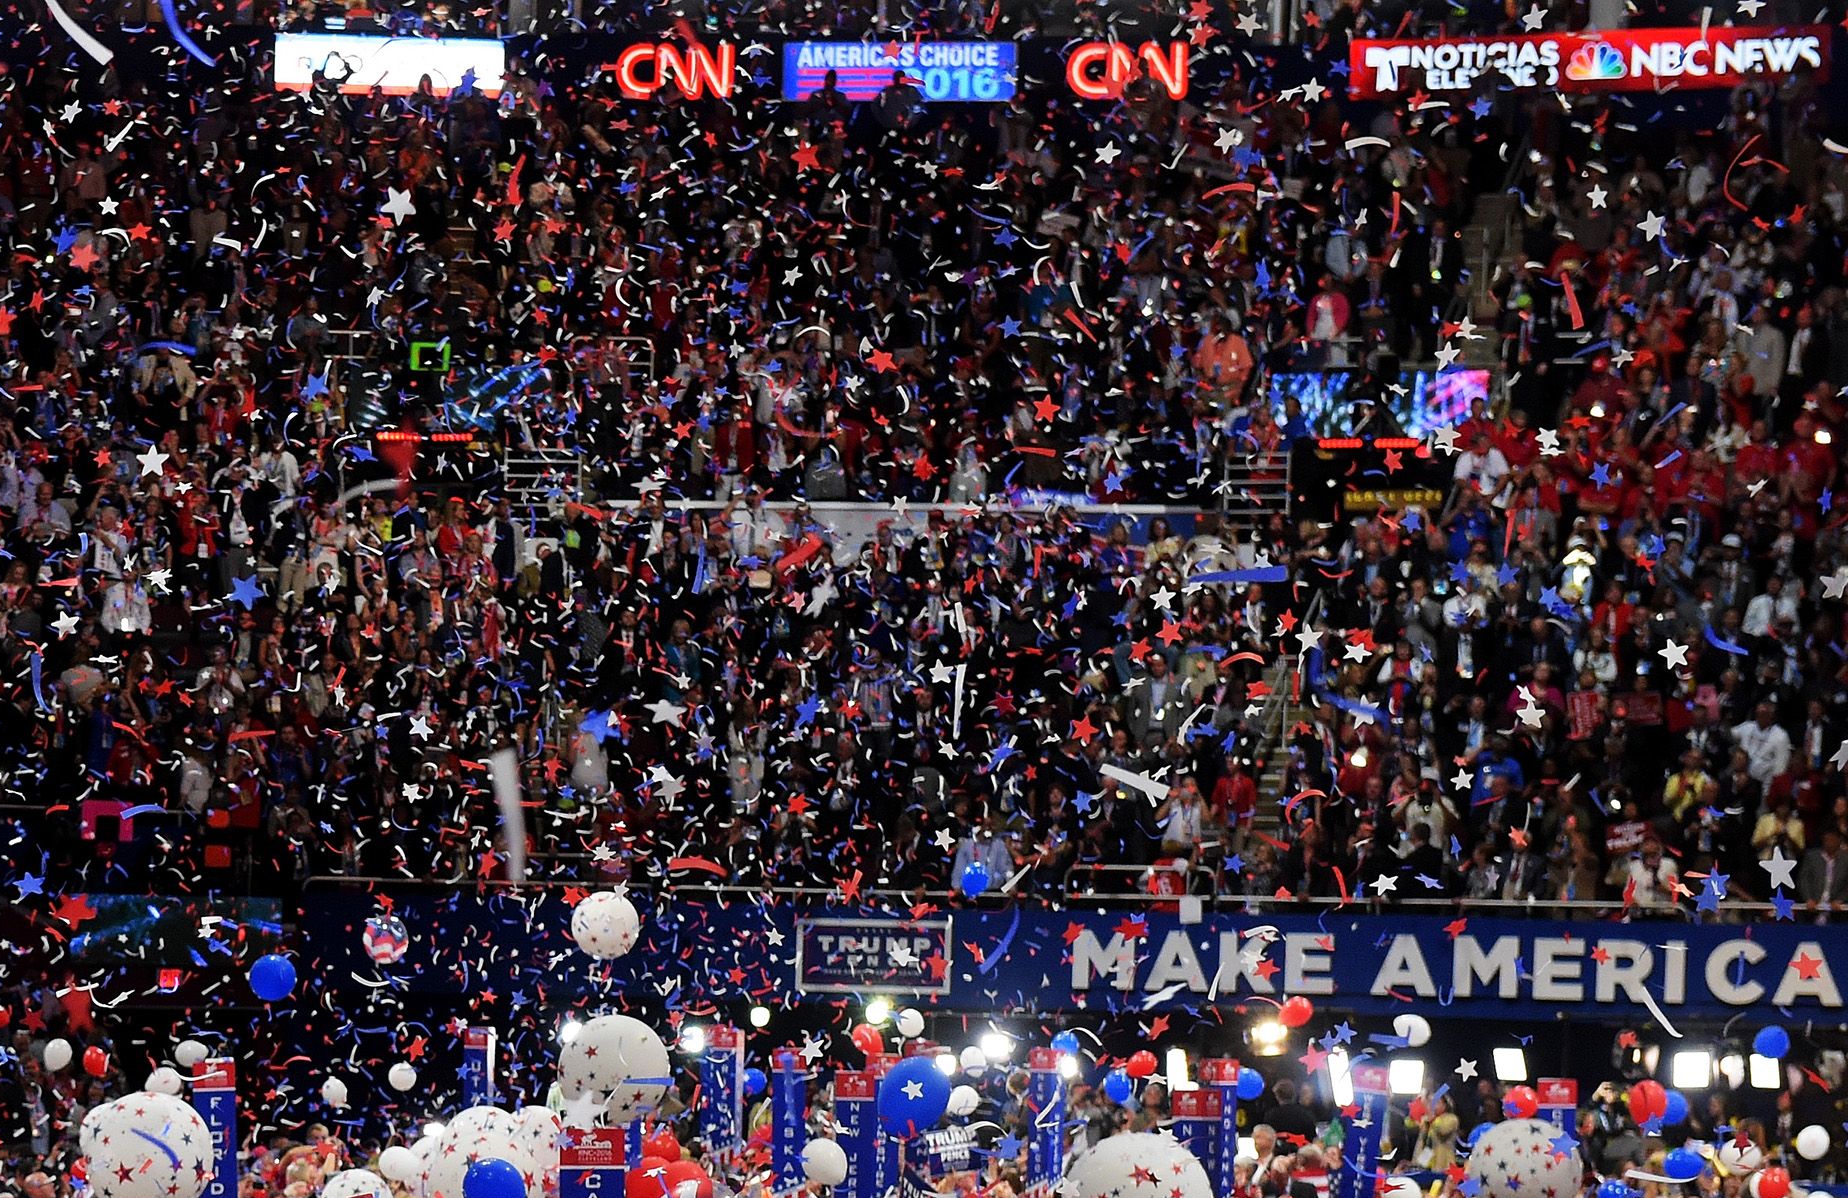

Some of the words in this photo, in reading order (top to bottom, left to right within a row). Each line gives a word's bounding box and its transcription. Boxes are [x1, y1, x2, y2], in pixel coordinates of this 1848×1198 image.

[616, 43, 734, 99] CNN
[797, 44, 915, 68] AMERICS
[919, 44, 999, 67] CHOICE
[1066, 40, 1189, 99] CNN
[1630, 41, 1711, 78] NBC
[1714, 36, 1823, 76] NEWS
[817, 935, 932, 954] TRUMP
[1071, 931, 1335, 995] MAKE
[1369, 933, 1845, 1006] AMERICA
[849, 1102, 860, 1138] NEW
[1221, 1089, 1231, 1188] INDIANA
